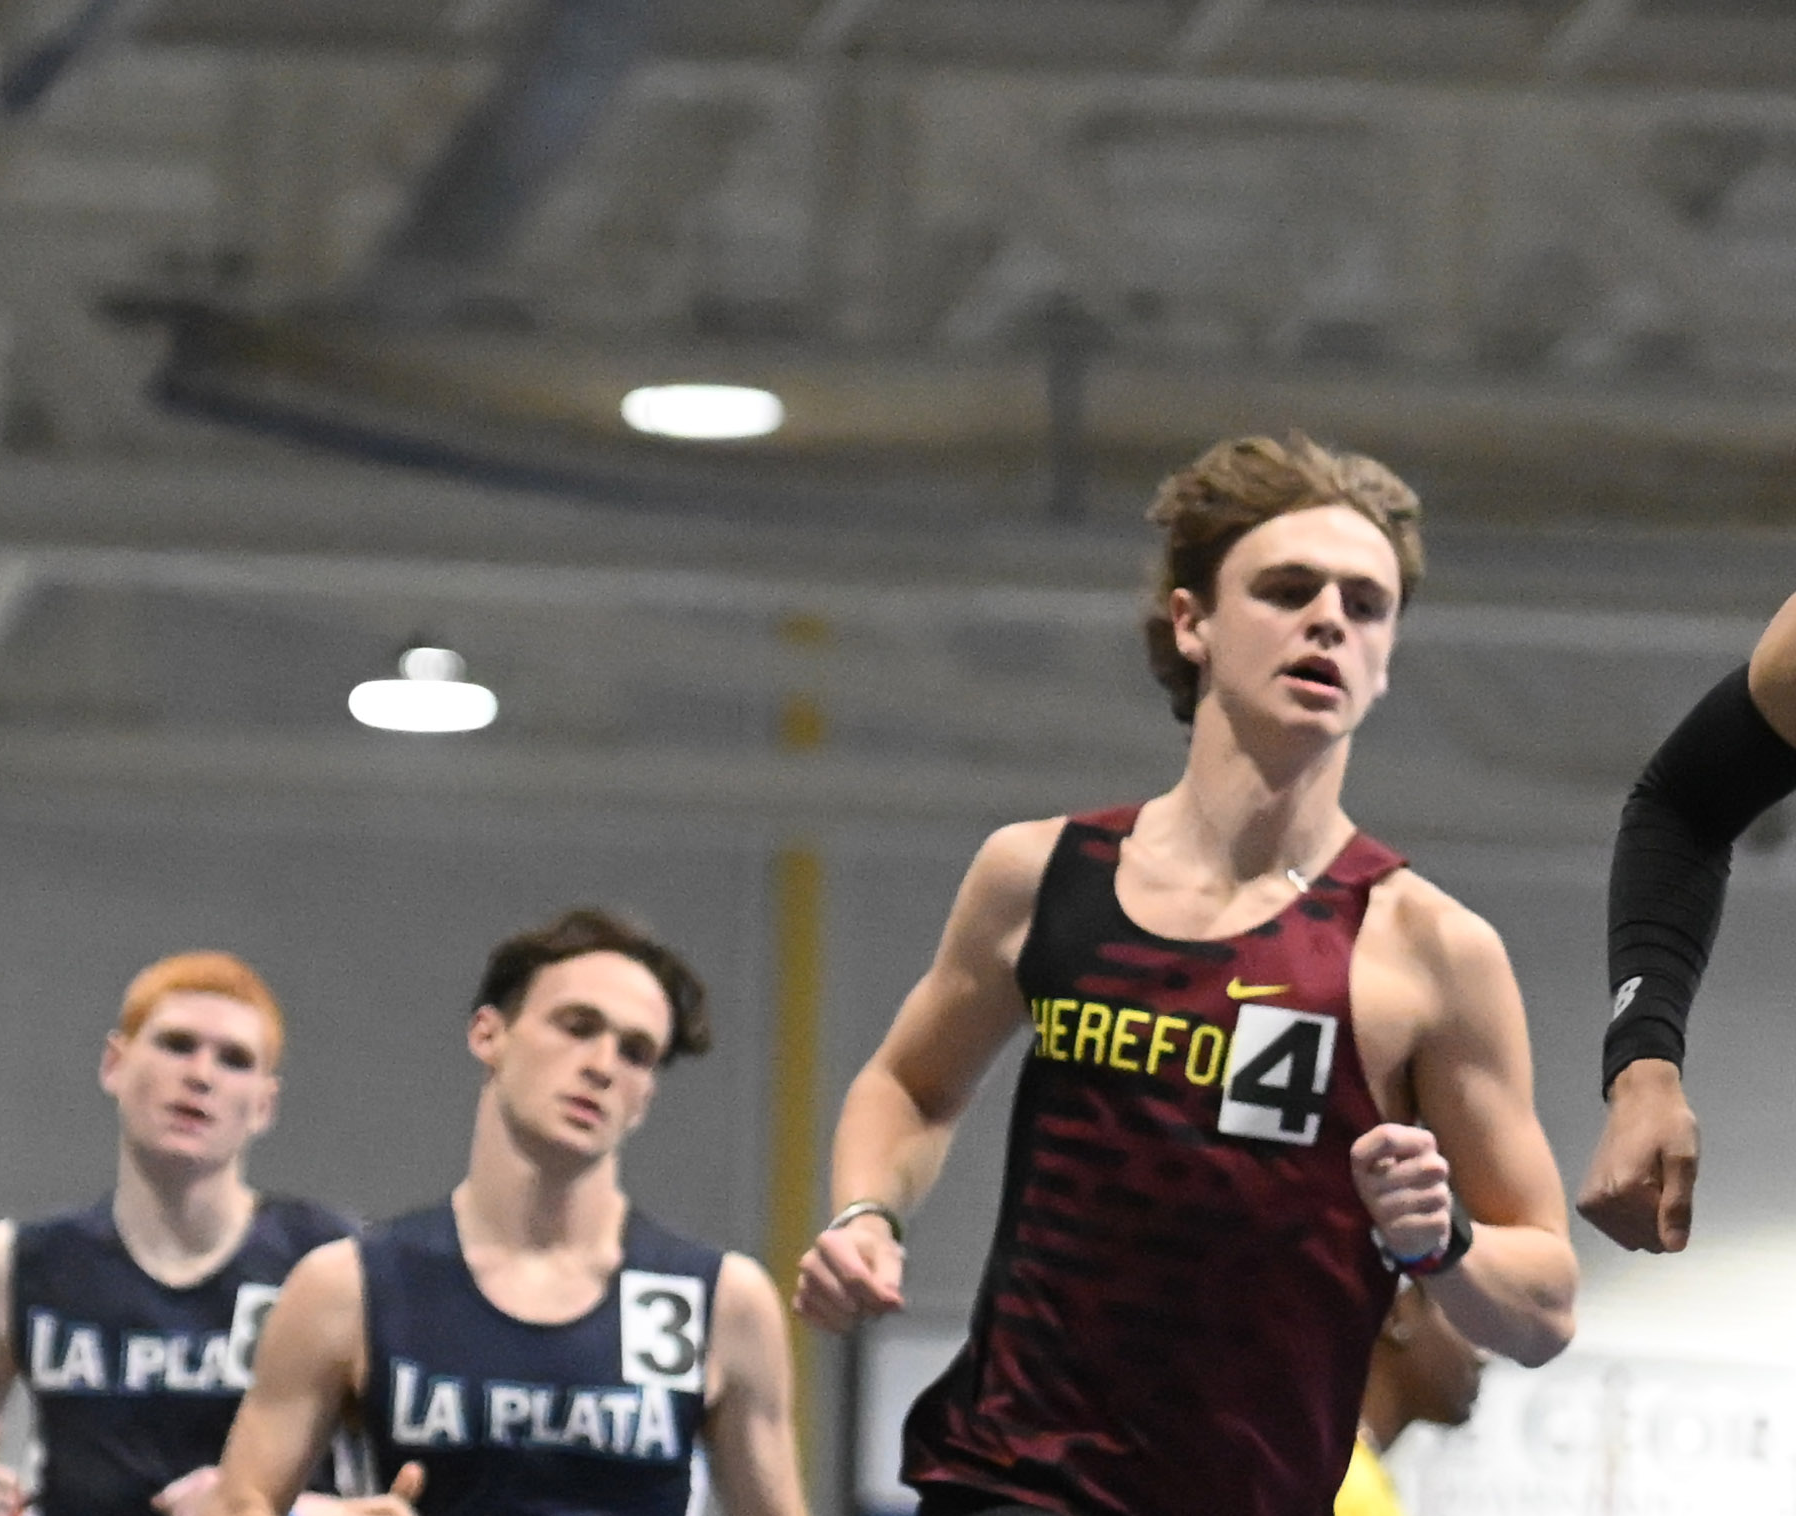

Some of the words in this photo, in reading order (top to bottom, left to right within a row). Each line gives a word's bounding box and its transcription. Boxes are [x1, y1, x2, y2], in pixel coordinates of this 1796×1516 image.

[1031, 998, 1236, 1087] HEREFO
[1228, 1019, 1329, 1134] 4
[29, 1311, 106, 1391] LA
[124, 1333, 234, 1392] PLA
[636, 1289, 696, 1376] 3
[390, 1358, 469, 1446] LA
[487, 1382, 681, 1459] PLATA
